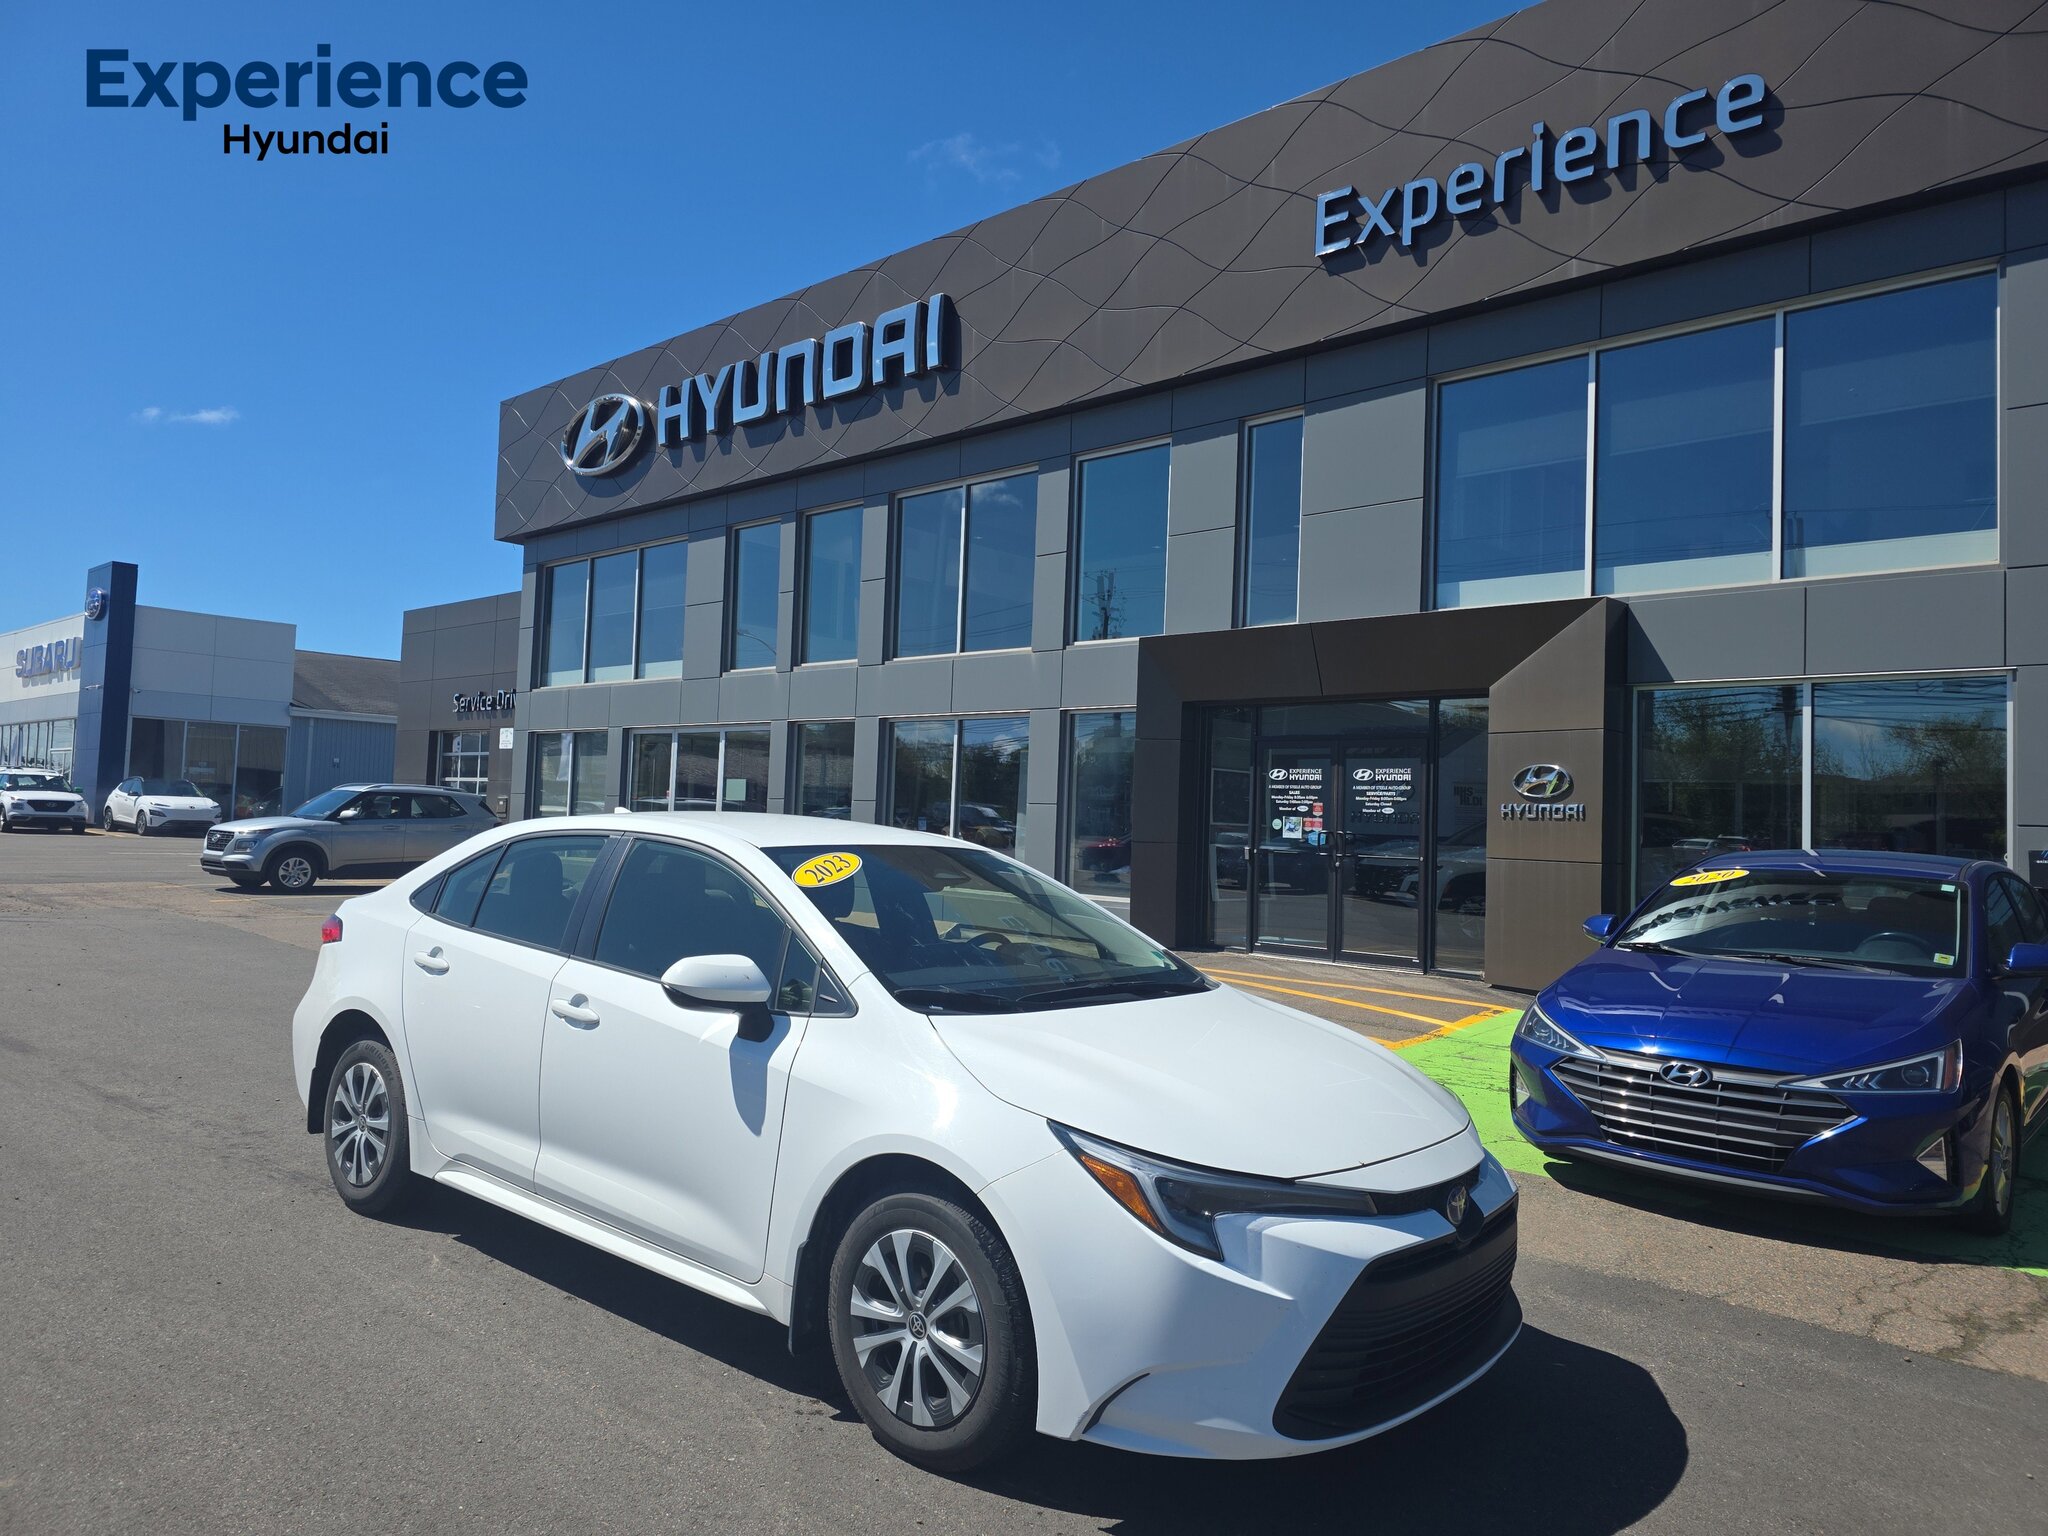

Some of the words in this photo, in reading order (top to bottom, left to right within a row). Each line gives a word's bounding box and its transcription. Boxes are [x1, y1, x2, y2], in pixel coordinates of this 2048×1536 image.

[1315, 73, 1766, 258] Experience
[657, 293, 947, 446] HYUNDAI
[16, 637, 82, 678] SUBARU
[453, 691, 492, 713] Service
[1500, 803, 1585, 820] HYUNDAI
[804, 855, 851, 883] 2023
[1683, 871, 1736, 884] 2020
